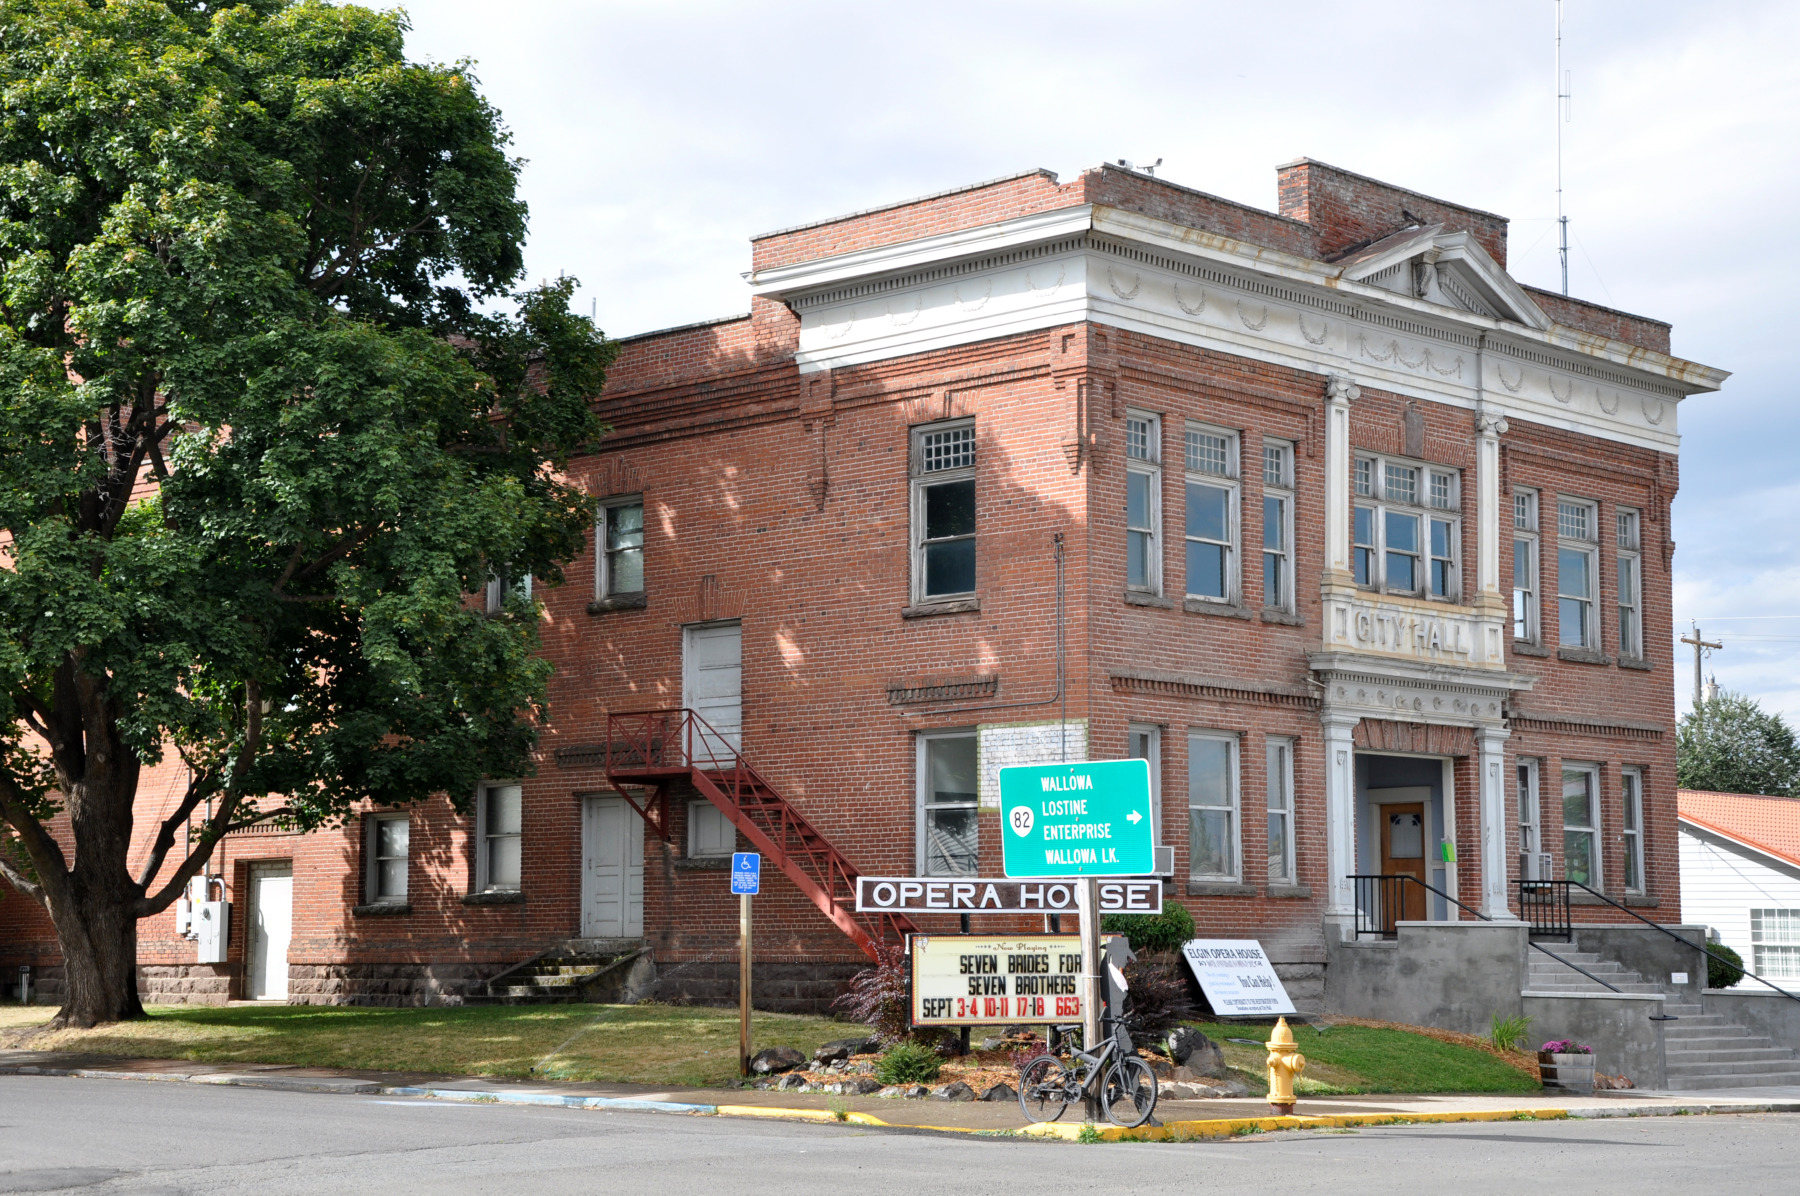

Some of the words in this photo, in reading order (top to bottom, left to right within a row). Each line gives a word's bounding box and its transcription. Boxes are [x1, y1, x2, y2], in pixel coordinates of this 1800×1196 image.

[1355, 611, 1405, 647] CITY
[1409, 618, 1468, 654] HALL
[1040, 774, 1094, 792] WALLOWA
[1042, 799, 1089, 817] LOSTINE
[1014, 811, 1030, 828] 82
[1043, 822, 1112, 841] ENTERPRISE
[1045, 848, 1098, 865] WALLOWA
[1101, 847, 1120, 864] LK.
[872, 882, 1003, 909] OPERA
[993, 942, 1014, 951] Now
[1016, 942, 1048, 952] Playing
[1187, 948, 1211, 959] ELGIN
[1210, 948, 1237, 959] OPERA
[1236, 948, 1264, 959] HOUSE
[959, 954, 998, 975] SEVEN
[1007, 954, 1050, 974] BRIDES
[1058, 954, 1082, 974] FOR
[968, 976, 1007, 996] SEVEN
[1015, 976, 1076, 996] BROTHERS
[922, 997, 953, 1018] SEPT
[957, 998, 979, 1018] 3-4
[983, 997, 1009, 1018] 10-11
[1016, 996, 1045, 1017] 17-18
